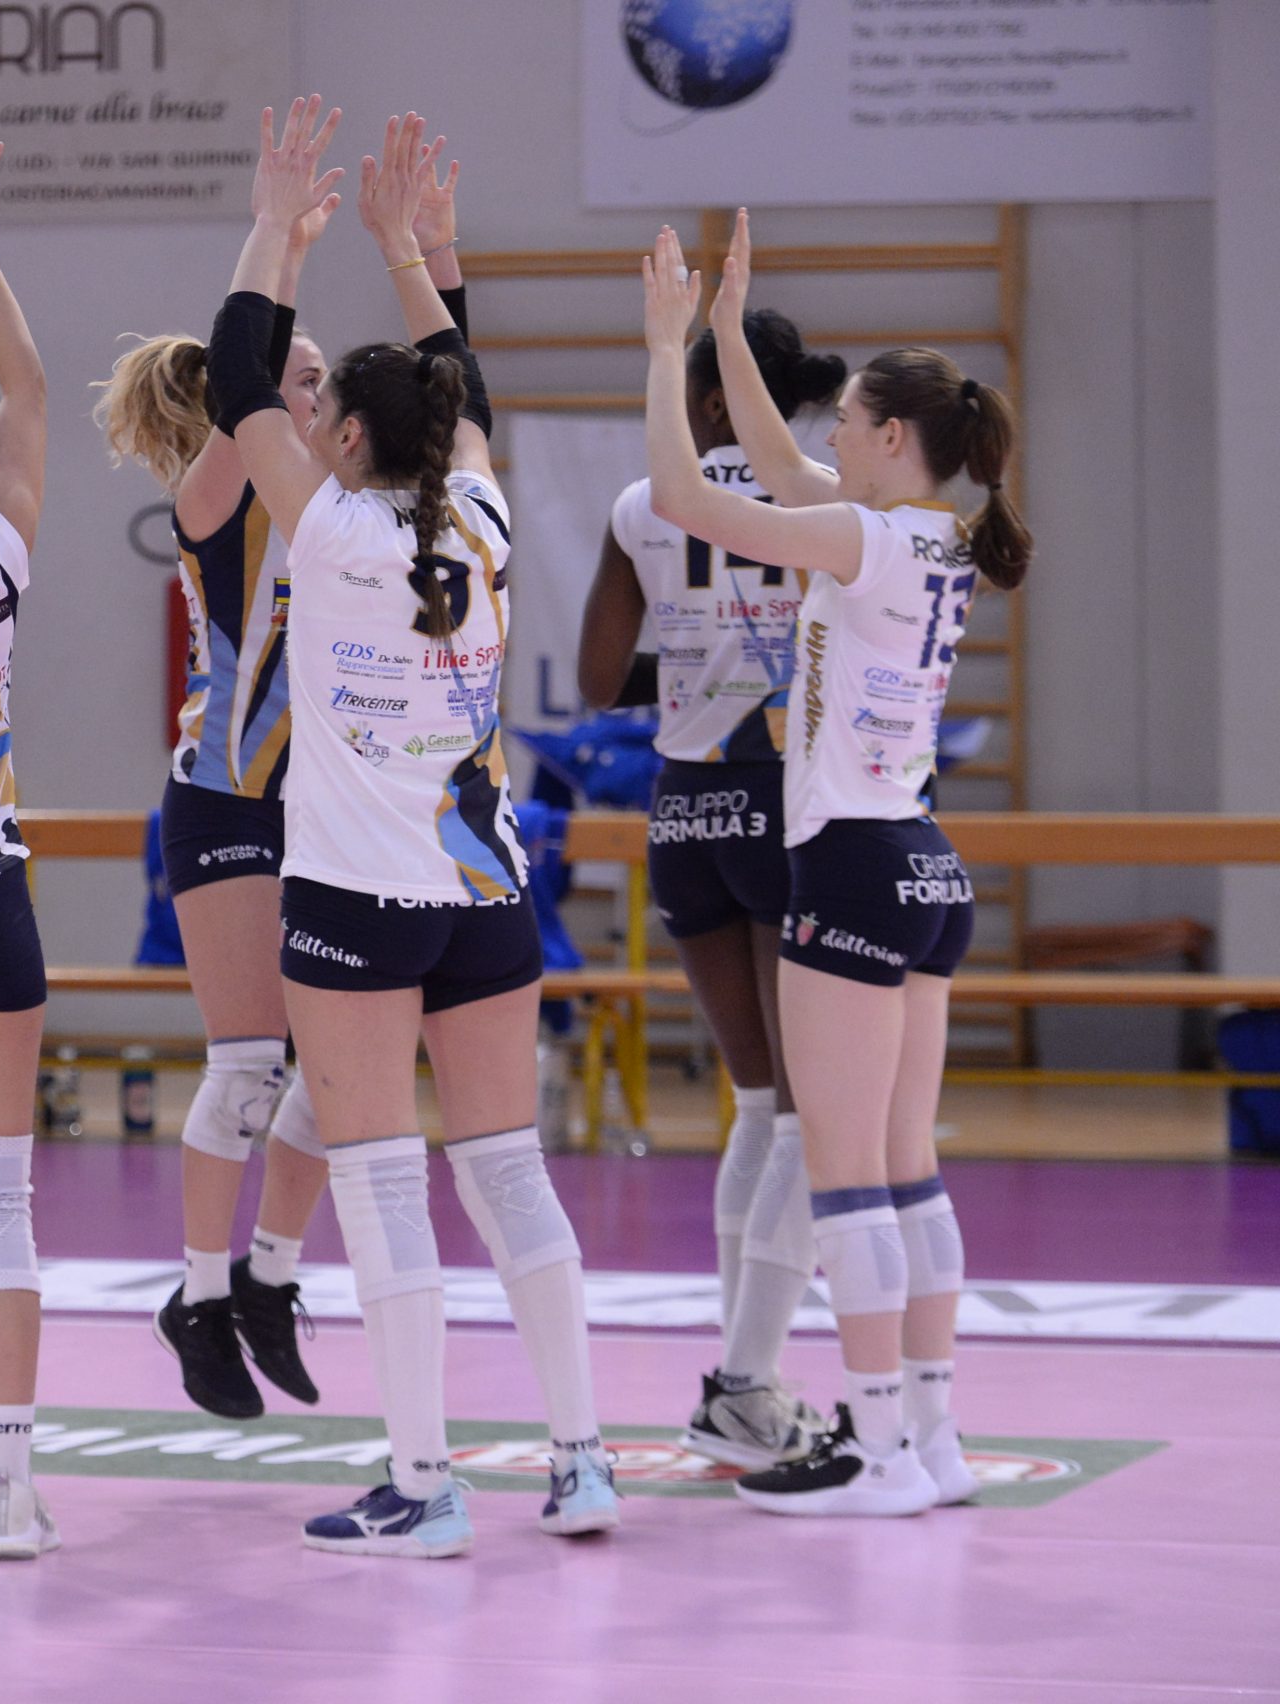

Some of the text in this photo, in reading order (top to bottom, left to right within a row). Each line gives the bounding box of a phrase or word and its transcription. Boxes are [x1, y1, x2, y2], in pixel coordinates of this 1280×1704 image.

[332, 641, 376, 661] GDS
[378, 655, 391, 664] De
[437, 649, 469, 669] like
[342, 693, 409, 712] TRICENTER
[365, 748, 389, 759] LAB
[656, 789, 749, 819] GRUPPO
[747, 811, 767, 837] 3
[288, 930, 369, 969] datterino
[820, 927, 909, 967] datterino
